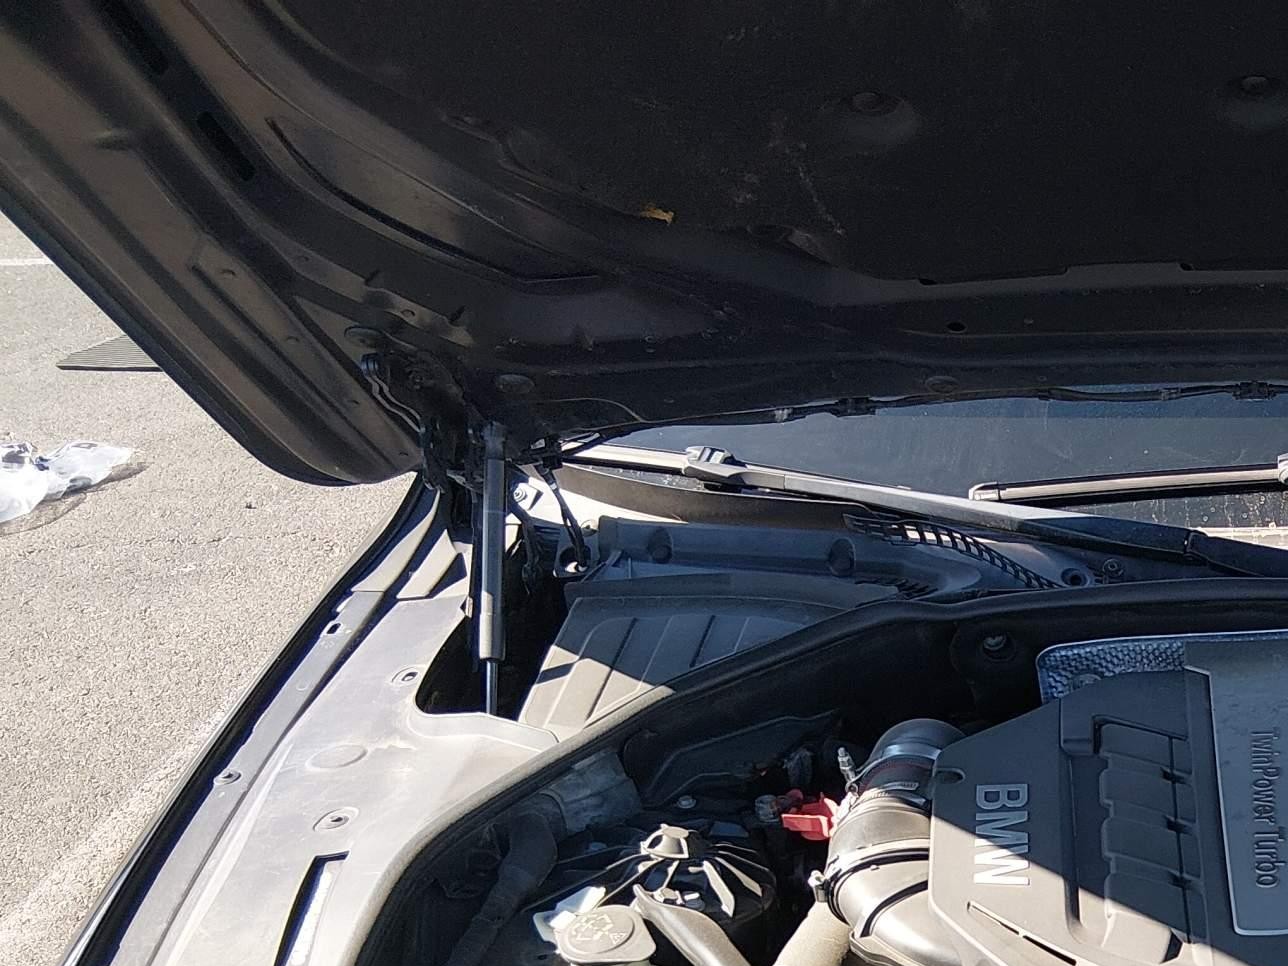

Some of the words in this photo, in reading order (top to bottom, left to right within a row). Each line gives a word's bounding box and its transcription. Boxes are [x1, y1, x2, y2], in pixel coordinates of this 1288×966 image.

[1250, 727, 1281, 826] TwinPower
[975, 783, 1030, 885] BMW
[1254, 826, 1286, 888] Turbo
